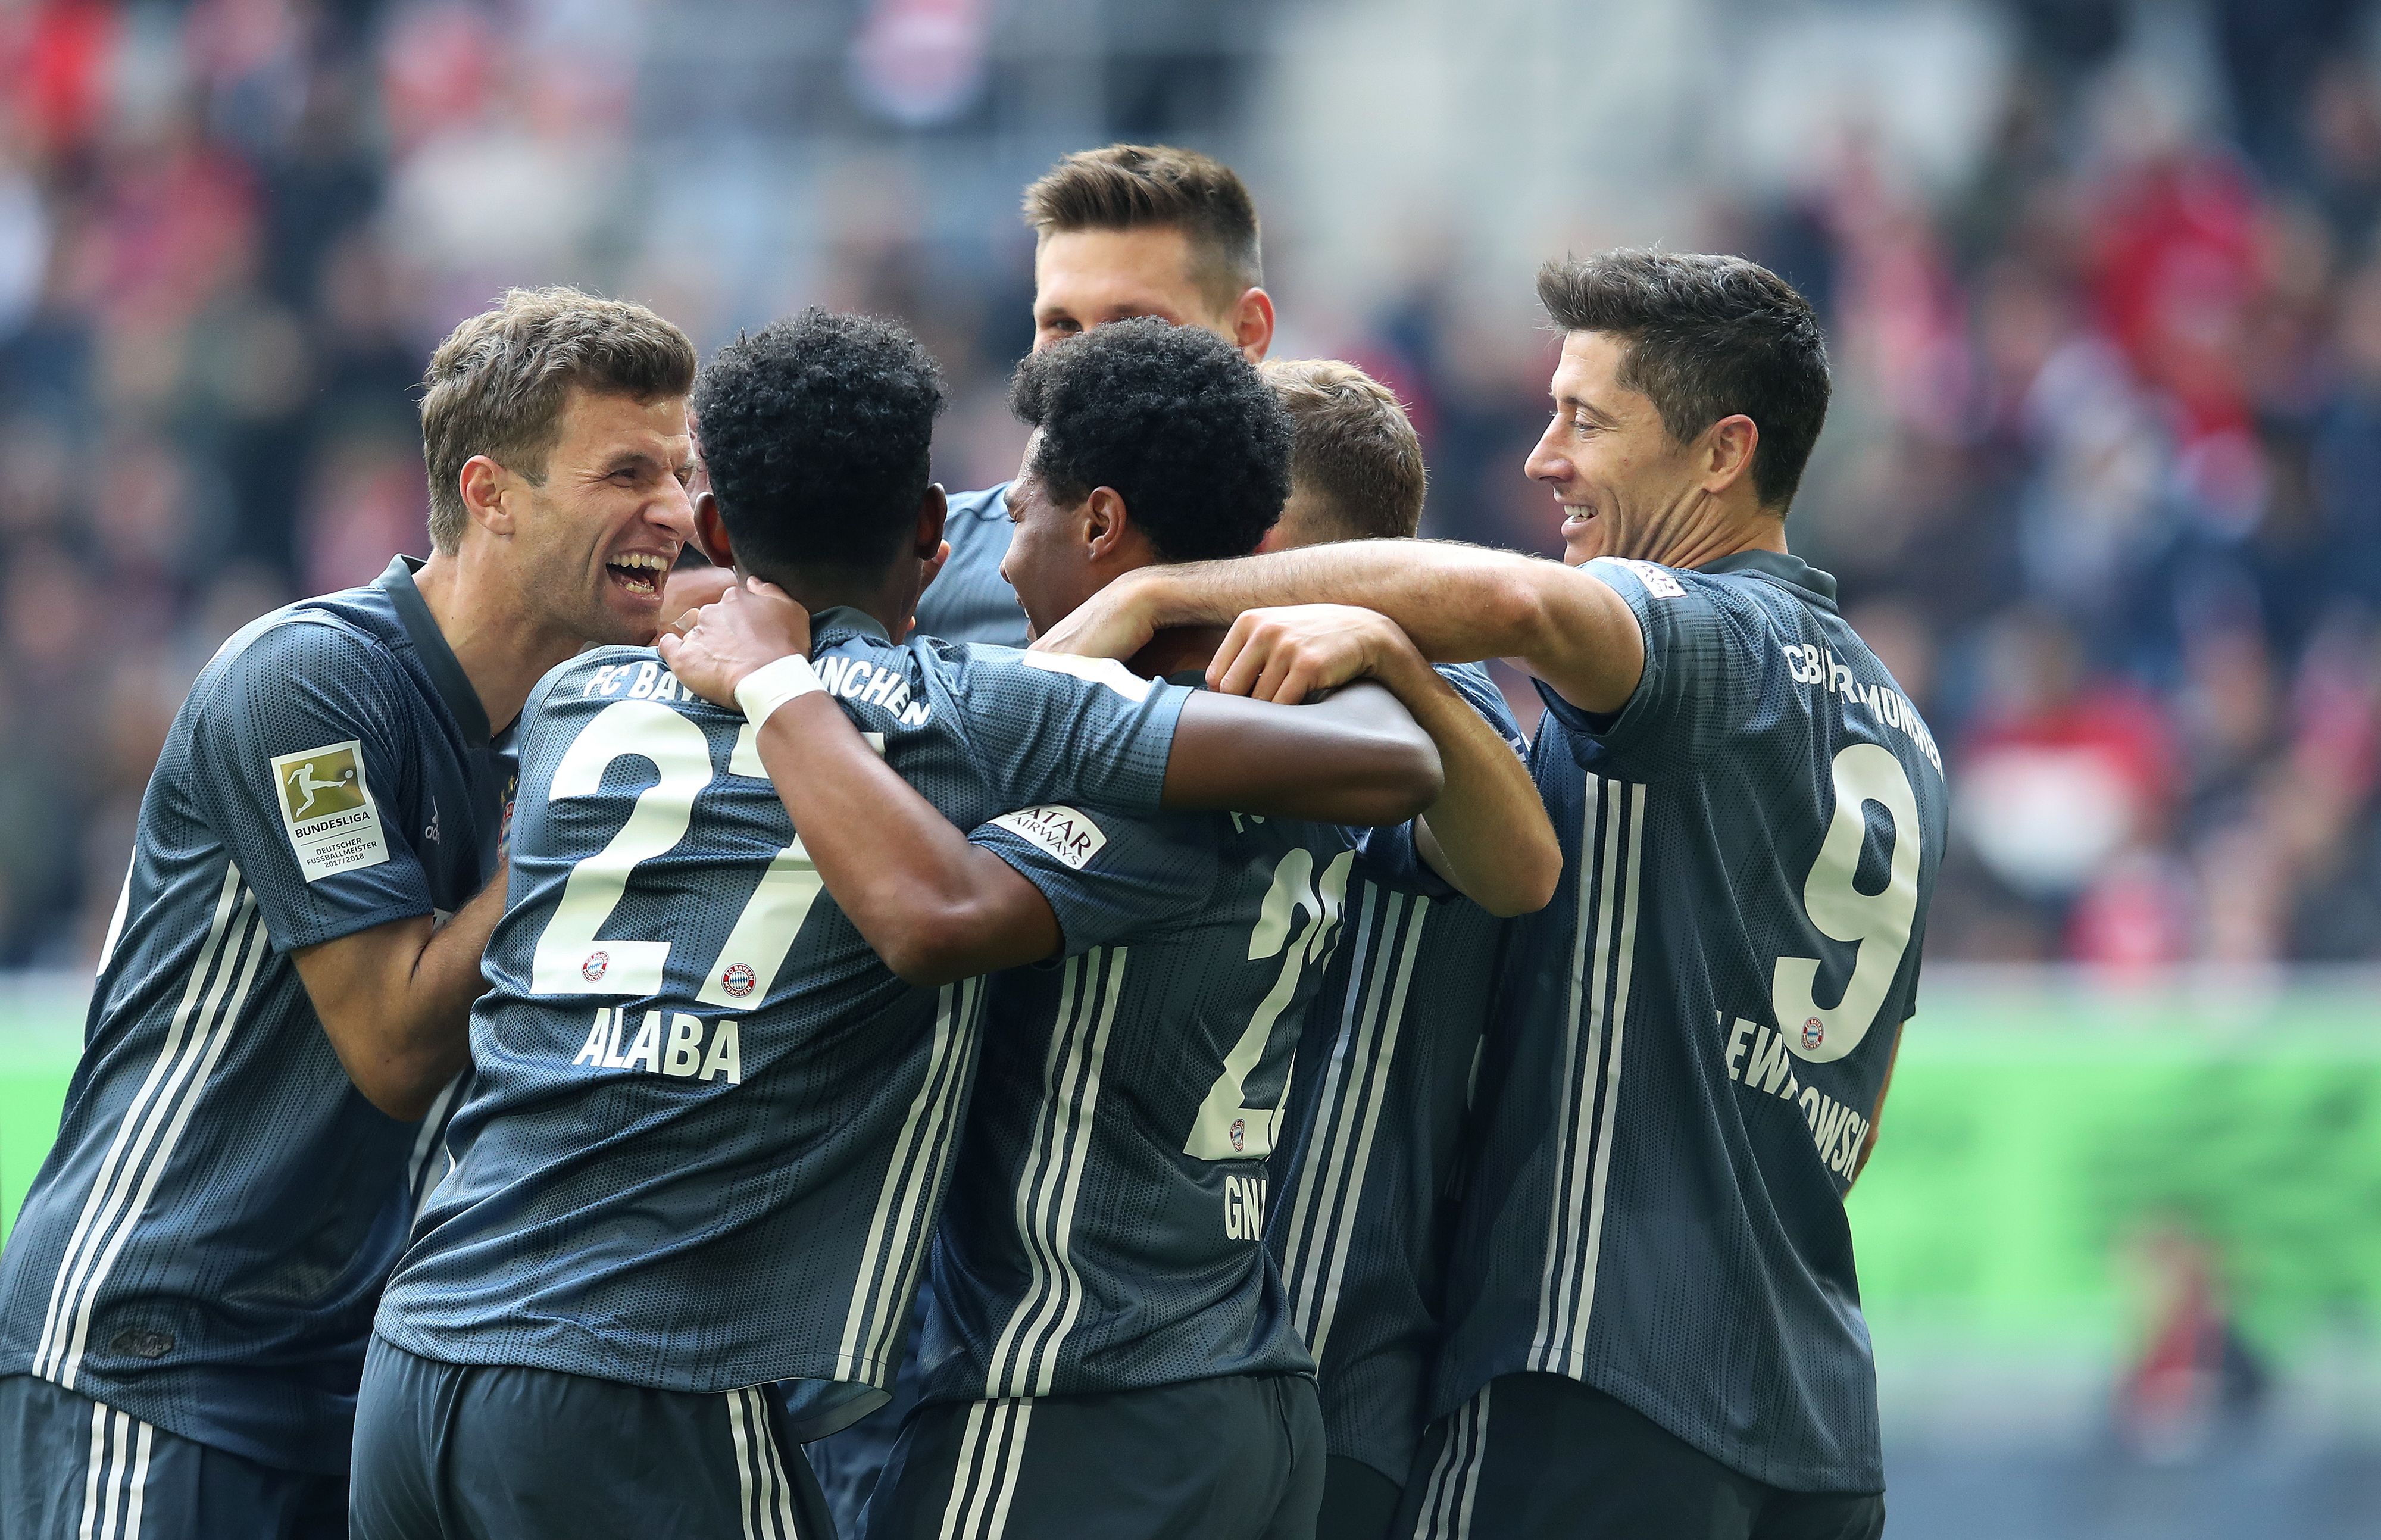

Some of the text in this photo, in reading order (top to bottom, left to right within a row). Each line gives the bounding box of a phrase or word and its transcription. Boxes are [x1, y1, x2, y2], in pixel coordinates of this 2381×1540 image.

[582, 664, 630, 698] FC
[811, 656, 931, 726] NCHEN
[295, 811, 370, 838] BUNDESLIGA
[316, 838, 362, 855] DEUTSCHER
[1006, 808, 1092, 857] ATAR
[1009, 817, 1080, 865] AIRWAYS
[307, 841, 377, 866] FUSSBALLMEISTER
[324, 853, 364, 868] 2017/2018
[530, 700, 885, 1010] 27
[1773, 743, 1920, 1063] 9
[734, 966, 754, 981] BAYERN
[572, 1007, 740, 1084] ALABA
